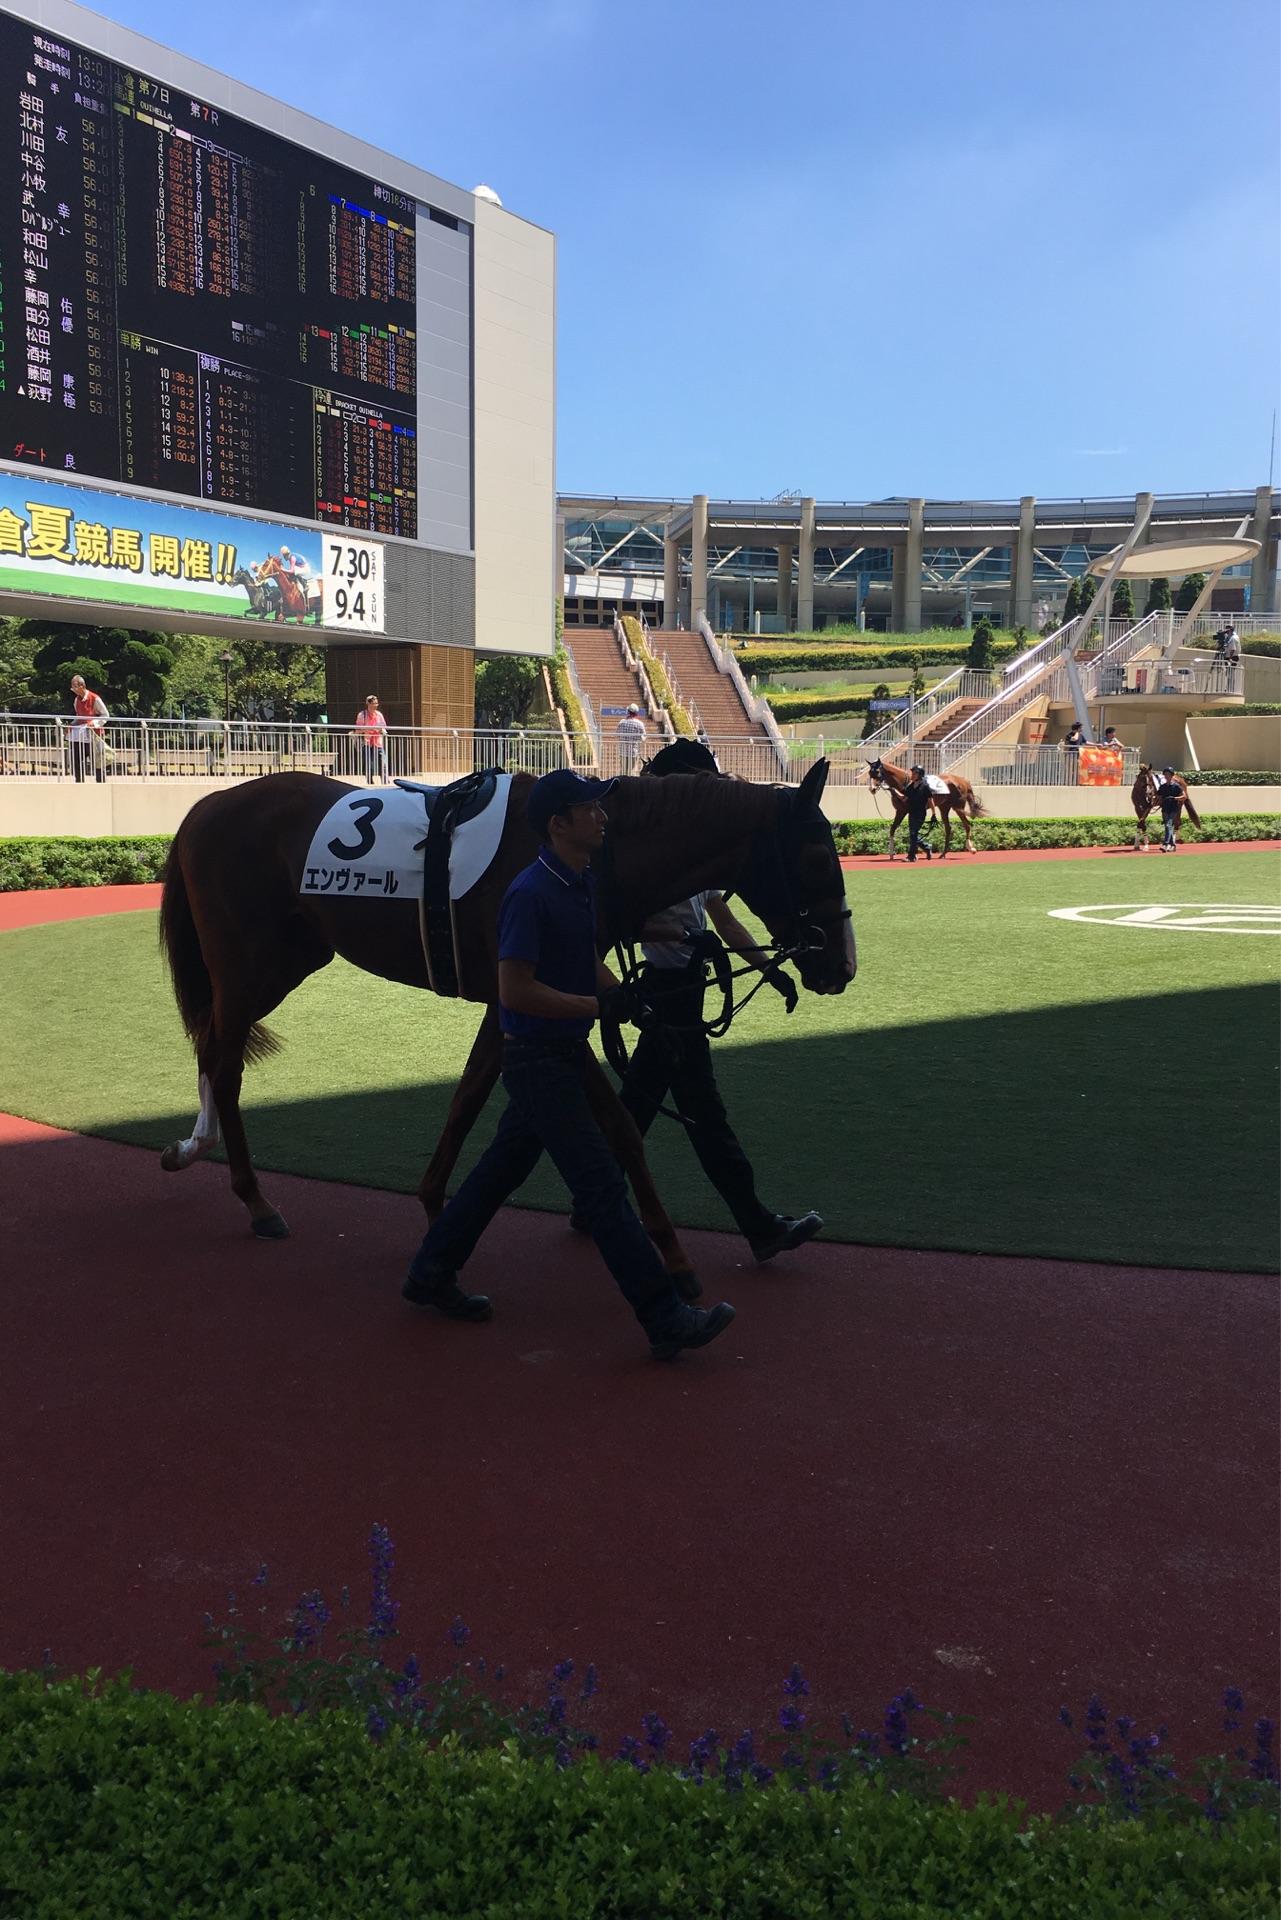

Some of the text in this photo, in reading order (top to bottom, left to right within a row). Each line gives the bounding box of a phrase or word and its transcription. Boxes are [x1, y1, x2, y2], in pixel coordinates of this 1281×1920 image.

[19, 91, 44, 114] 岩田
[20, 111, 44, 134] 北村
[56, 126, 68, 144] 友
[21, 130, 45, 153] 川田
[21, 151, 45, 172] 中谷
[22, 190, 35, 208] 武
[22, 228, 47, 250] 和田
[23, 248, 48, 270] 松山
[25, 286, 49, 309] 藤岡
[26, 306, 50, 327] 国分
[26, 325, 50, 346] 松田
[120, 332, 159, 356] 単勝 WIN
[26, 344, 51, 365] 酒井
[27, 363, 51, 385] 藤岡
[160, 367, 170, 380] 10
[160, 380, 169, 392] 11
[161, 394, 170, 407] 12
[161, 408, 171, 420] 13
[161, 421, 171, 433] 14
[162, 434, 172, 446] 15
[15, 443, 76, 470] ダート 良
[162, 448, 172, 460] 16
[330, 545, 370, 581] 7.30
[335, 588, 366, 622] 9.4
[327, 797, 384, 861] 3
[305, 867, 398, 894] エンヴァール
